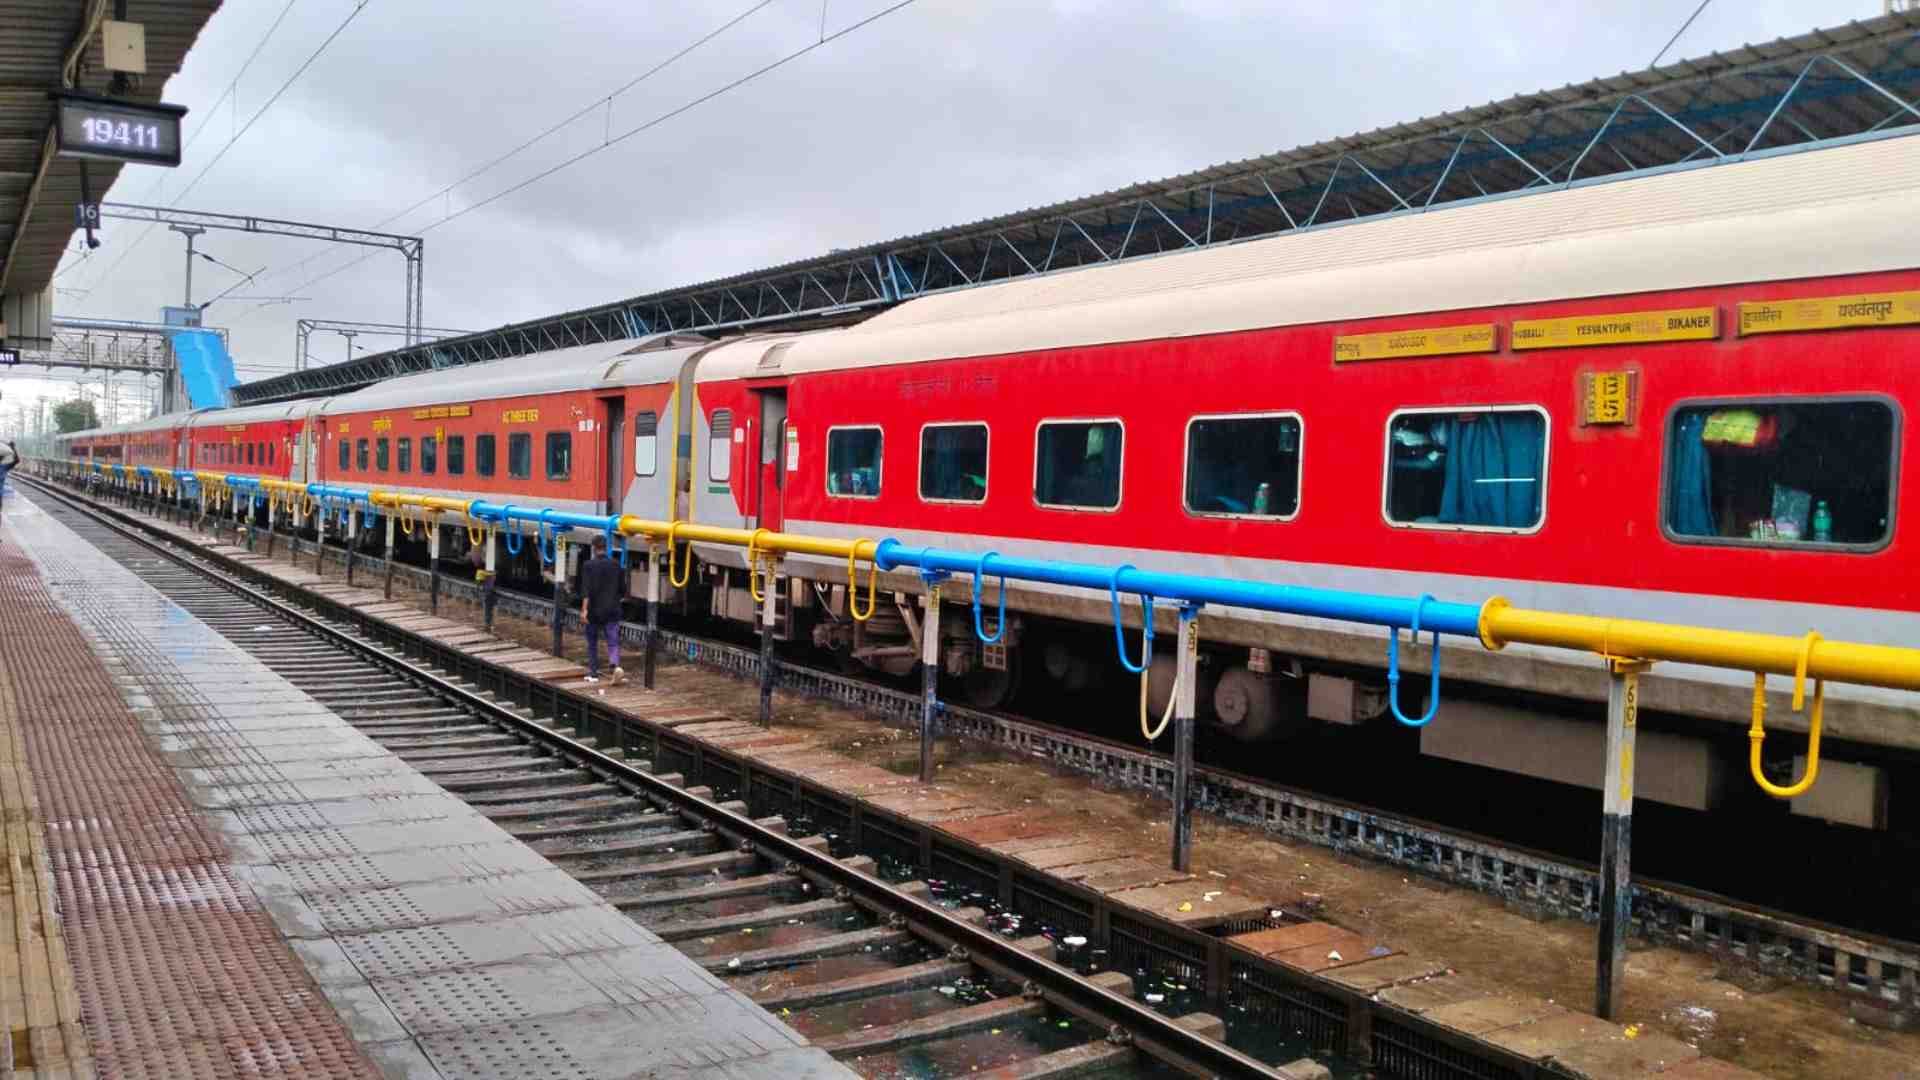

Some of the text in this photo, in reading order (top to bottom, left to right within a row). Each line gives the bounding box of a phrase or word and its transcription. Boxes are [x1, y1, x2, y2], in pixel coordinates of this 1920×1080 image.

[82, 118, 158, 148] 19411
[1576, 323, 1632, 336] YESVANTPUR
[1667, 315, 1711, 330] BIKANER
[1627, 685, 1635, 722] 60
